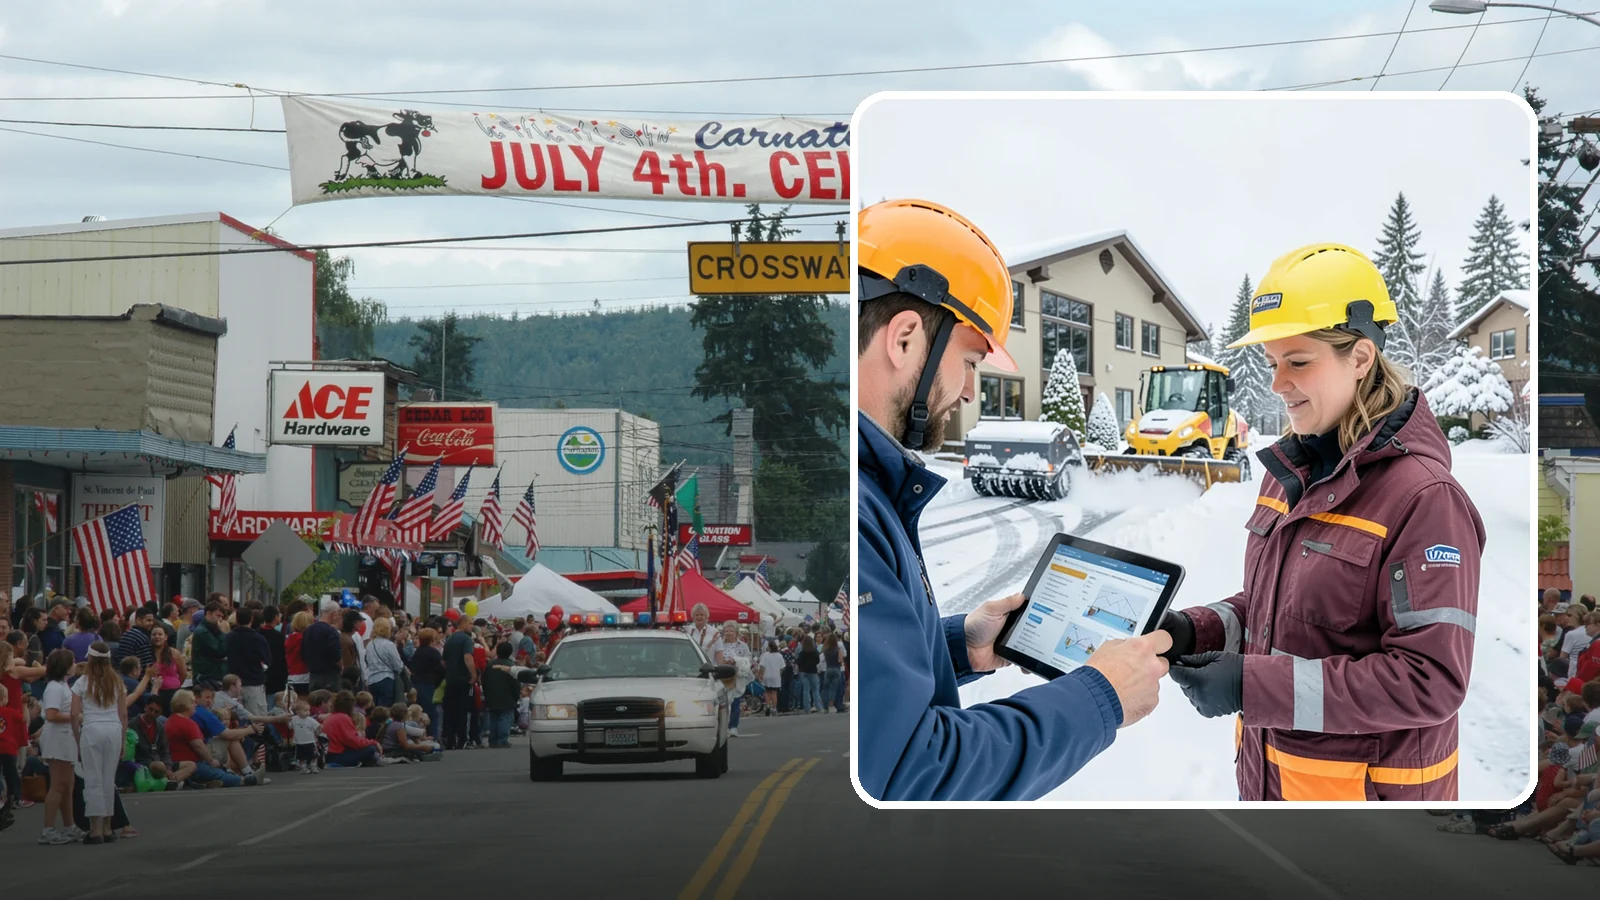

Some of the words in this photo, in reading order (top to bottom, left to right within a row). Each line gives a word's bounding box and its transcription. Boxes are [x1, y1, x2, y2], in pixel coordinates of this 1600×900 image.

[481, 141, 605, 193] JULY
[632, 150, 747, 198] 4th.
[697, 254, 850, 280] CROSSWA
[283, 380, 374, 420] ACE
[406, 409, 452, 422] CEDAR
[283, 421, 371, 437] Hardware
[83, 485, 94, 494] St.
[95, 485, 124, 495] Vincent
[126, 485, 136, 494] de
[137, 486, 155, 495] Paul
[80, 503, 154, 522] THT
[688, 526, 741, 535] CRNATION
[699, 535, 730, 543] GLASS
